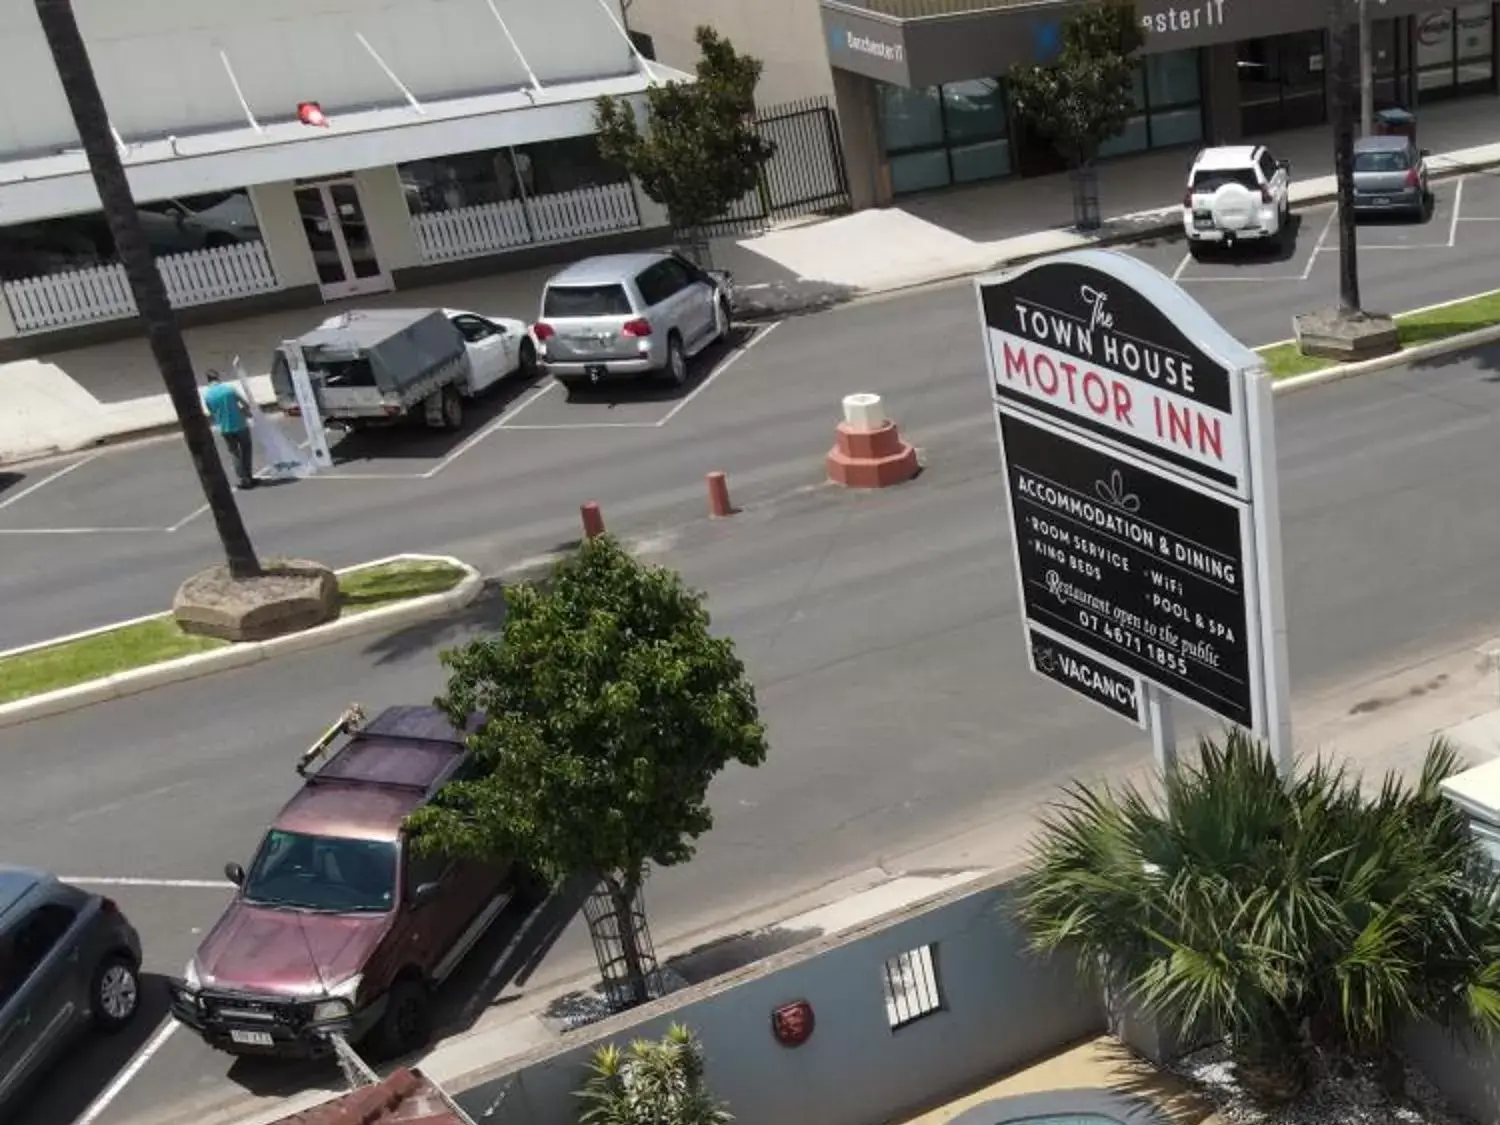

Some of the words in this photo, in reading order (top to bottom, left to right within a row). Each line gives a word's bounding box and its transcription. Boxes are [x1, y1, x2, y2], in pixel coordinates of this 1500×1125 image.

[1206, 0, 1225, 25] IT
[1080, 284, 1114, 332] The
[1015, 303, 1093, 355] TOWN
[1103, 335, 1195, 392] HOUSE
[1003, 341, 1134, 428] MOTOR
[1153, 396, 1223, 461] INN
[1018, 475, 1154, 549] ACCOMMODATION
[1159, 536, 1171, 556] &
[1175, 543, 1235, 585] DINING
[1032, 516, 1071, 545] ROOM
[1073, 535, 1130, 572] SERVICE
[1034, 540, 1066, 564] KING
[1069, 554, 1102, 581] BEDS
[1045, 569, 1111, 616] Restaurant
[1113, 606, 1141, 631] open
[1143, 619, 1157, 637] to
[1159, 623, 1180, 647] the
[1180, 638, 1221, 668] public
[1078, 611, 1099, 631] 07
[1103, 622, 1141, 654] 4671
[1147, 643, 1188, 676] 1855
[1152, 593, 1191, 624] POOL
[1194, 613, 1205, 630] &
[1208, 619, 1236, 645] SPA
[1058, 653, 1137, 710] VACANCY
